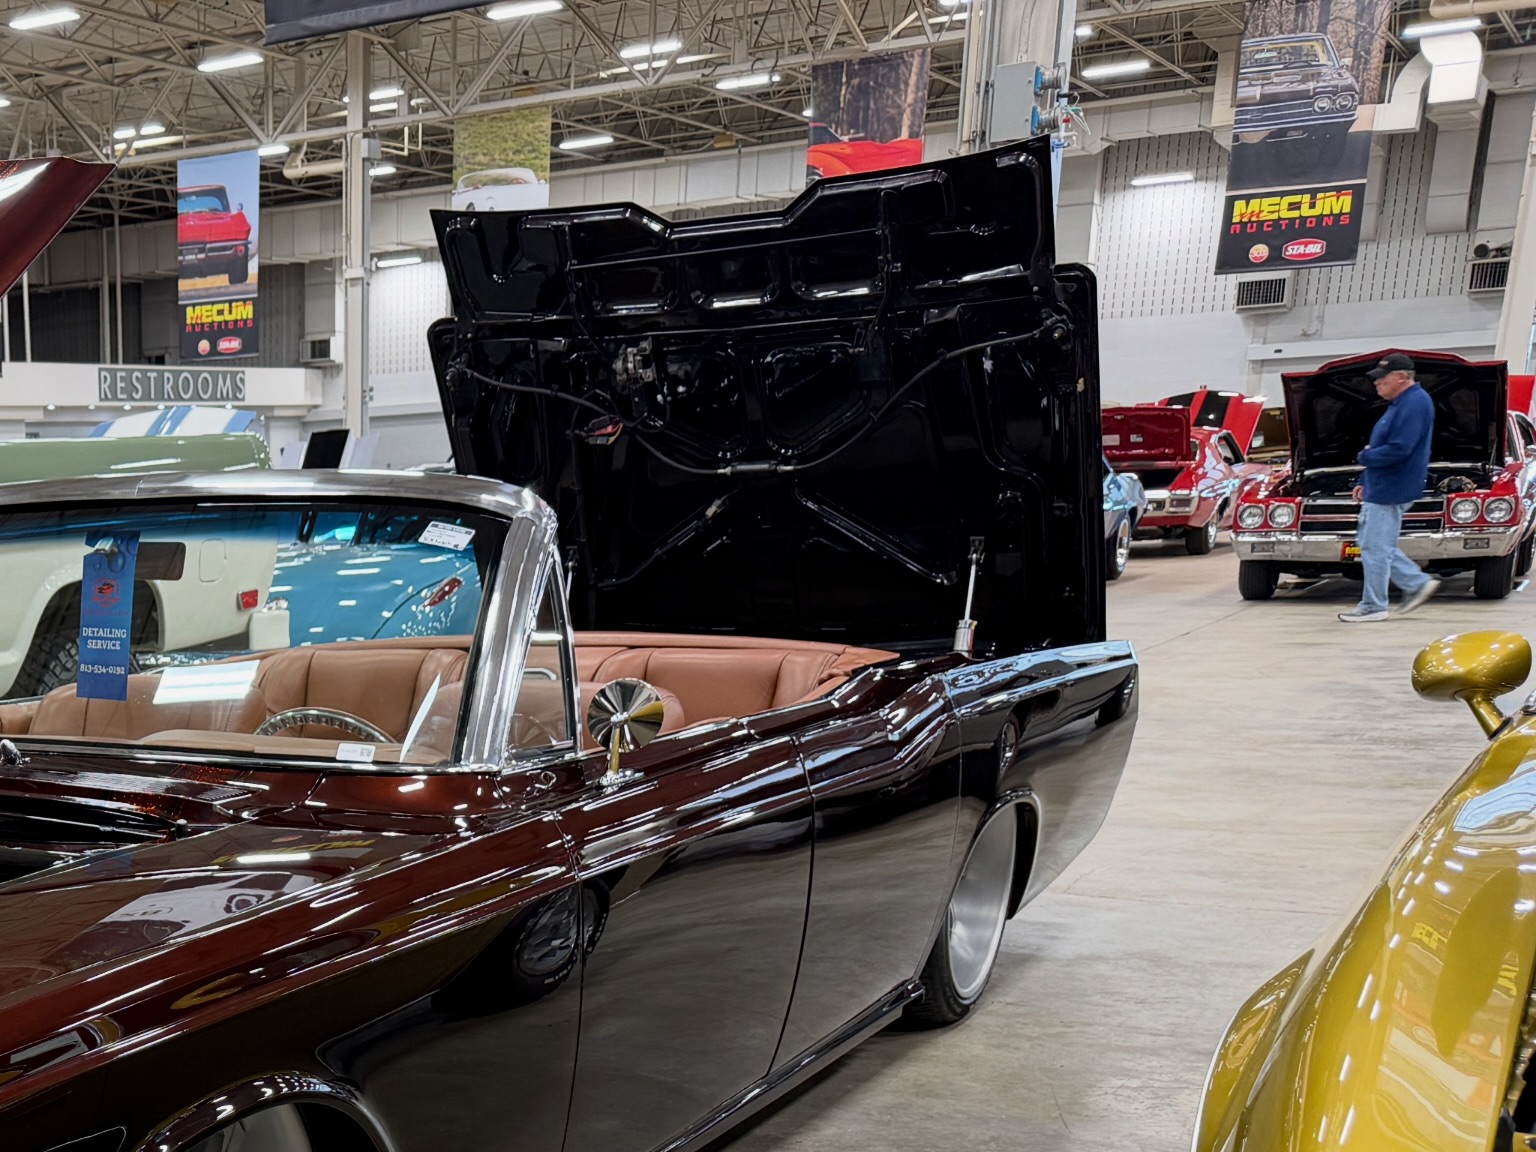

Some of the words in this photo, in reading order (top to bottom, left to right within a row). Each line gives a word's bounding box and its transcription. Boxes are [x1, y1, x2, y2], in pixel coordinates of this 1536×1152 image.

[1232, 190, 1353, 223] MECUM
[1230, 214, 1350, 234] AUCTIONS
[1285, 243, 1323, 256] STA-BIL
[186, 300, 253, 324] MECUM
[185, 319, 253, 333] AUCTIONS
[100, 370, 245, 400] RESTROOMS
[82, 627, 127, 638] DETAILING
[86, 640, 121, 650] SERVICE
